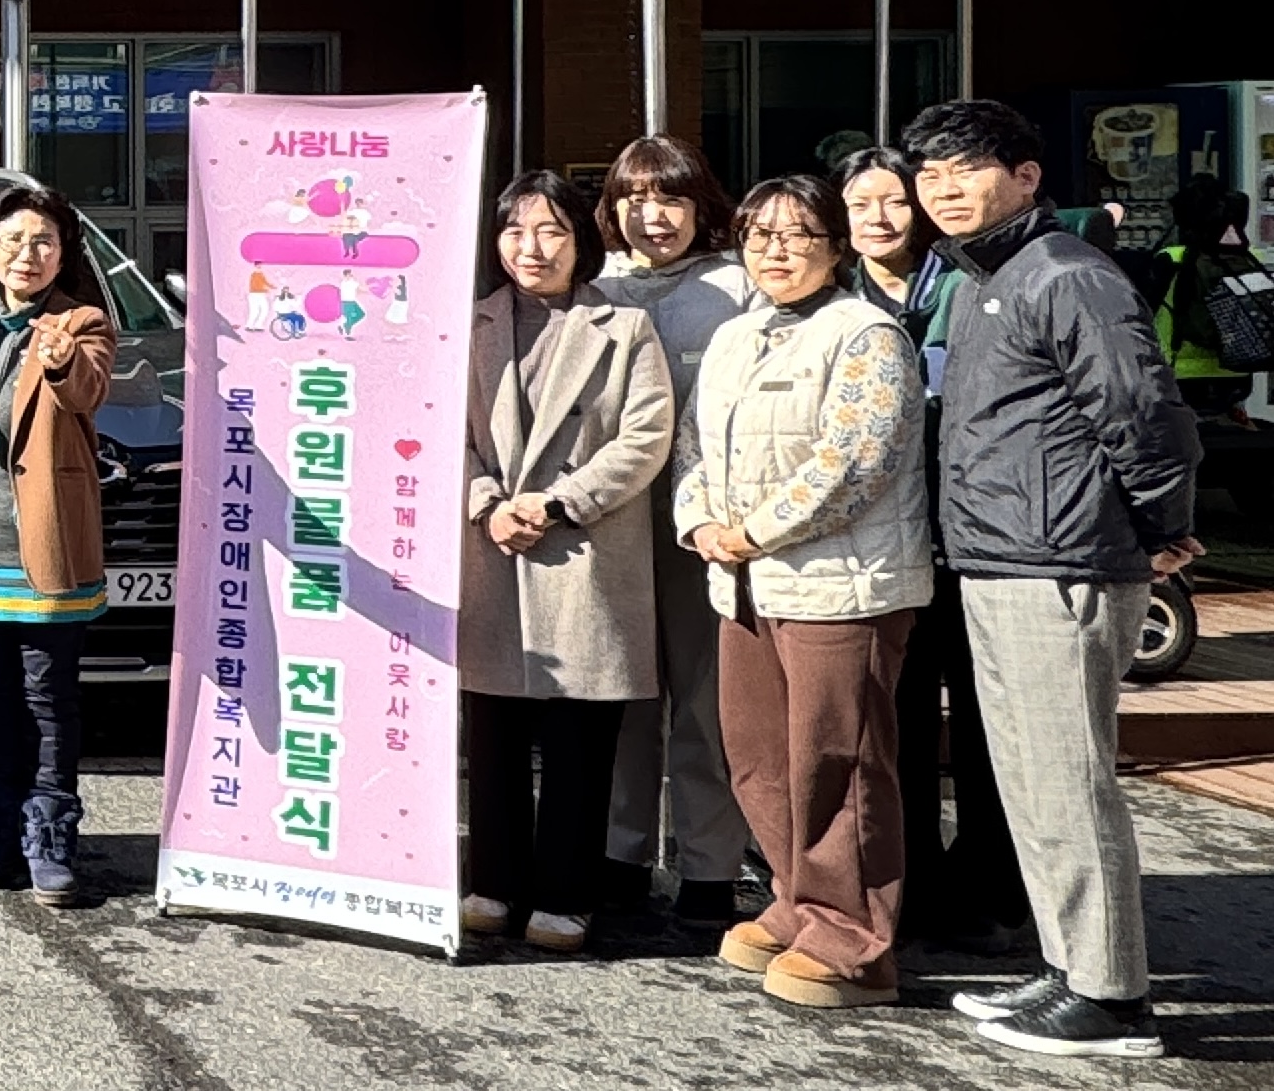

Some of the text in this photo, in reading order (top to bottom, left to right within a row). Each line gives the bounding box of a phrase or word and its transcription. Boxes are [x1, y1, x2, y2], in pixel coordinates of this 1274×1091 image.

[266, 130, 390, 158] 사랑나눔
[278, 366, 349, 851] 후원물품 전달식
[385, 630, 412, 752] 이웃사랑
[212, 870, 268, 896] 목포시
[344, 891, 445, 926] 종합복지관
